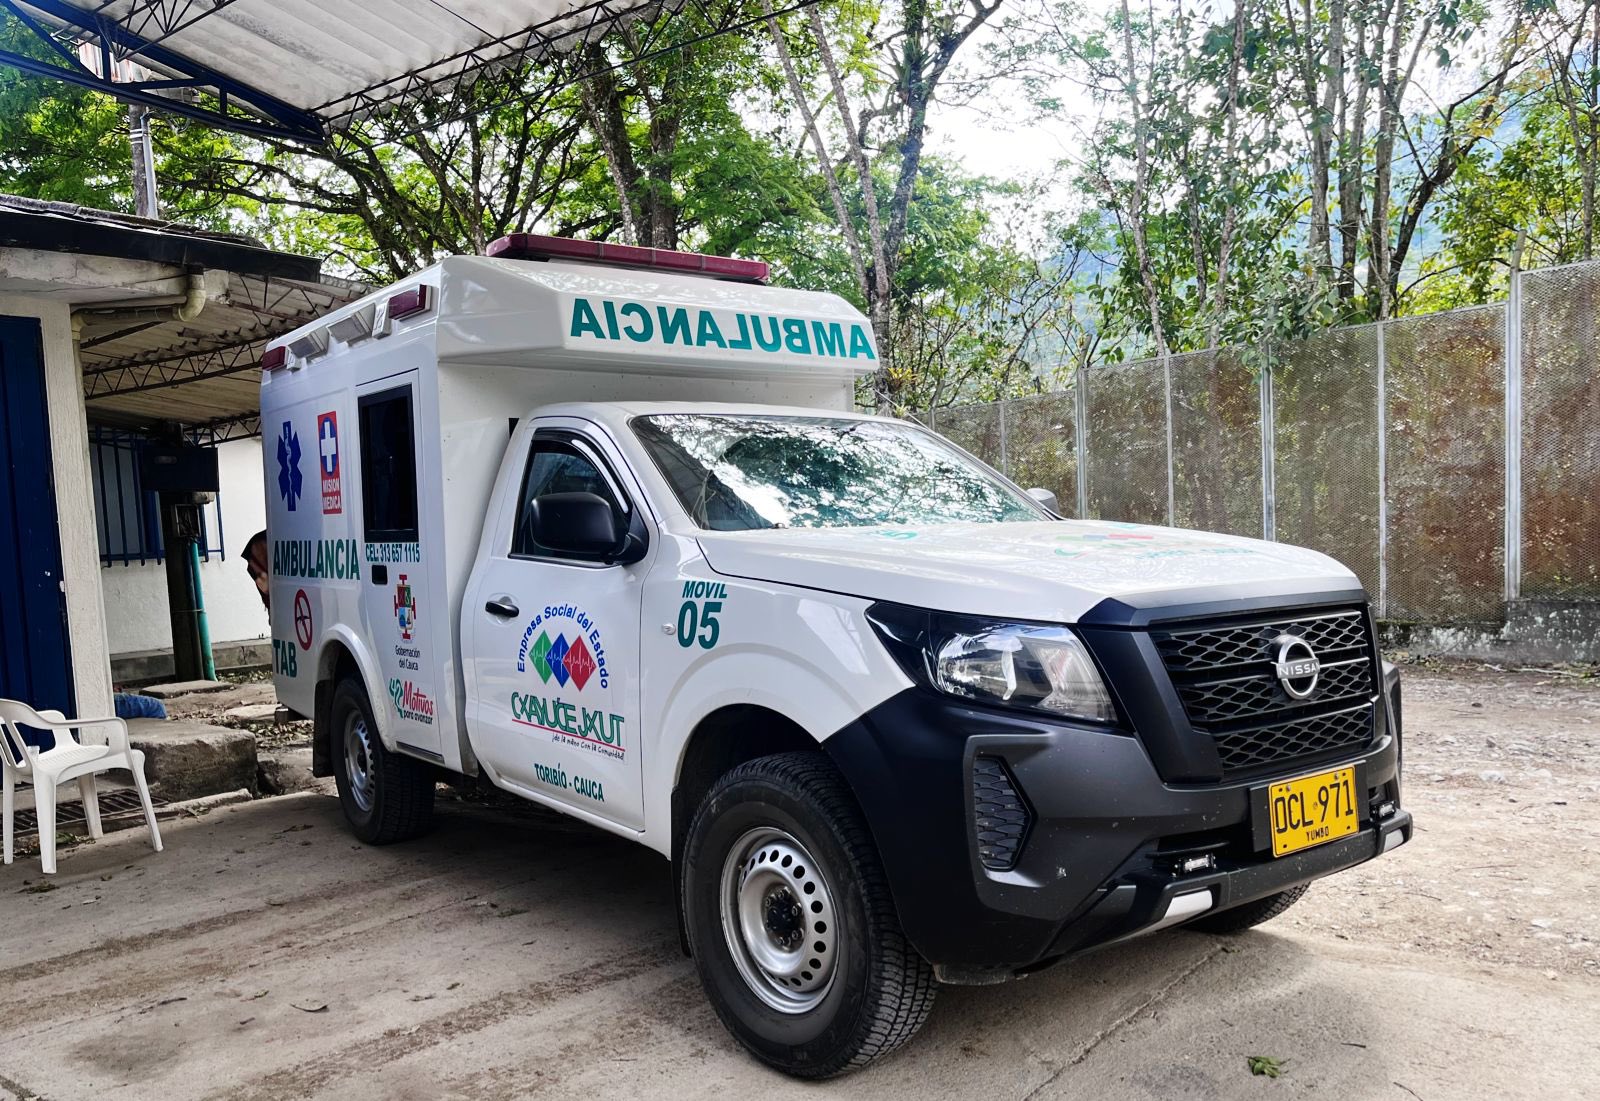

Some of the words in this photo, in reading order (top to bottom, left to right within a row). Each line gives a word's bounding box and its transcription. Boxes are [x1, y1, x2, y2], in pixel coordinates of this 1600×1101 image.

[273, 539, 360, 580] AMBULANCIA
[380, 543, 390, 562] 313
[392, 543, 402, 562] 657
[405, 543, 420, 562] 1115
[682, 581, 727, 598] MOVIL
[678, 600, 722, 649] 05
[273, 639, 298, 677] TAB
[406, 659, 418, 670] Cauca
[517, 610, 542, 673] Empresa
[544, 603, 578, 619] Social
[576, 612, 593, 632] del
[589, 629, 609, 689] Estado
[403, 681, 433, 716] Motivos
[403, 710, 414, 720] para
[578, 707, 624, 747] JXUT
[534, 762, 567, 789] TORIBÍO
[574, 775, 604, 802] CAUCA
[1274, 791, 1313, 833] DCL
[1318, 779, 1354, 822] 971
[1306, 826, 1329, 841] YUMBO
